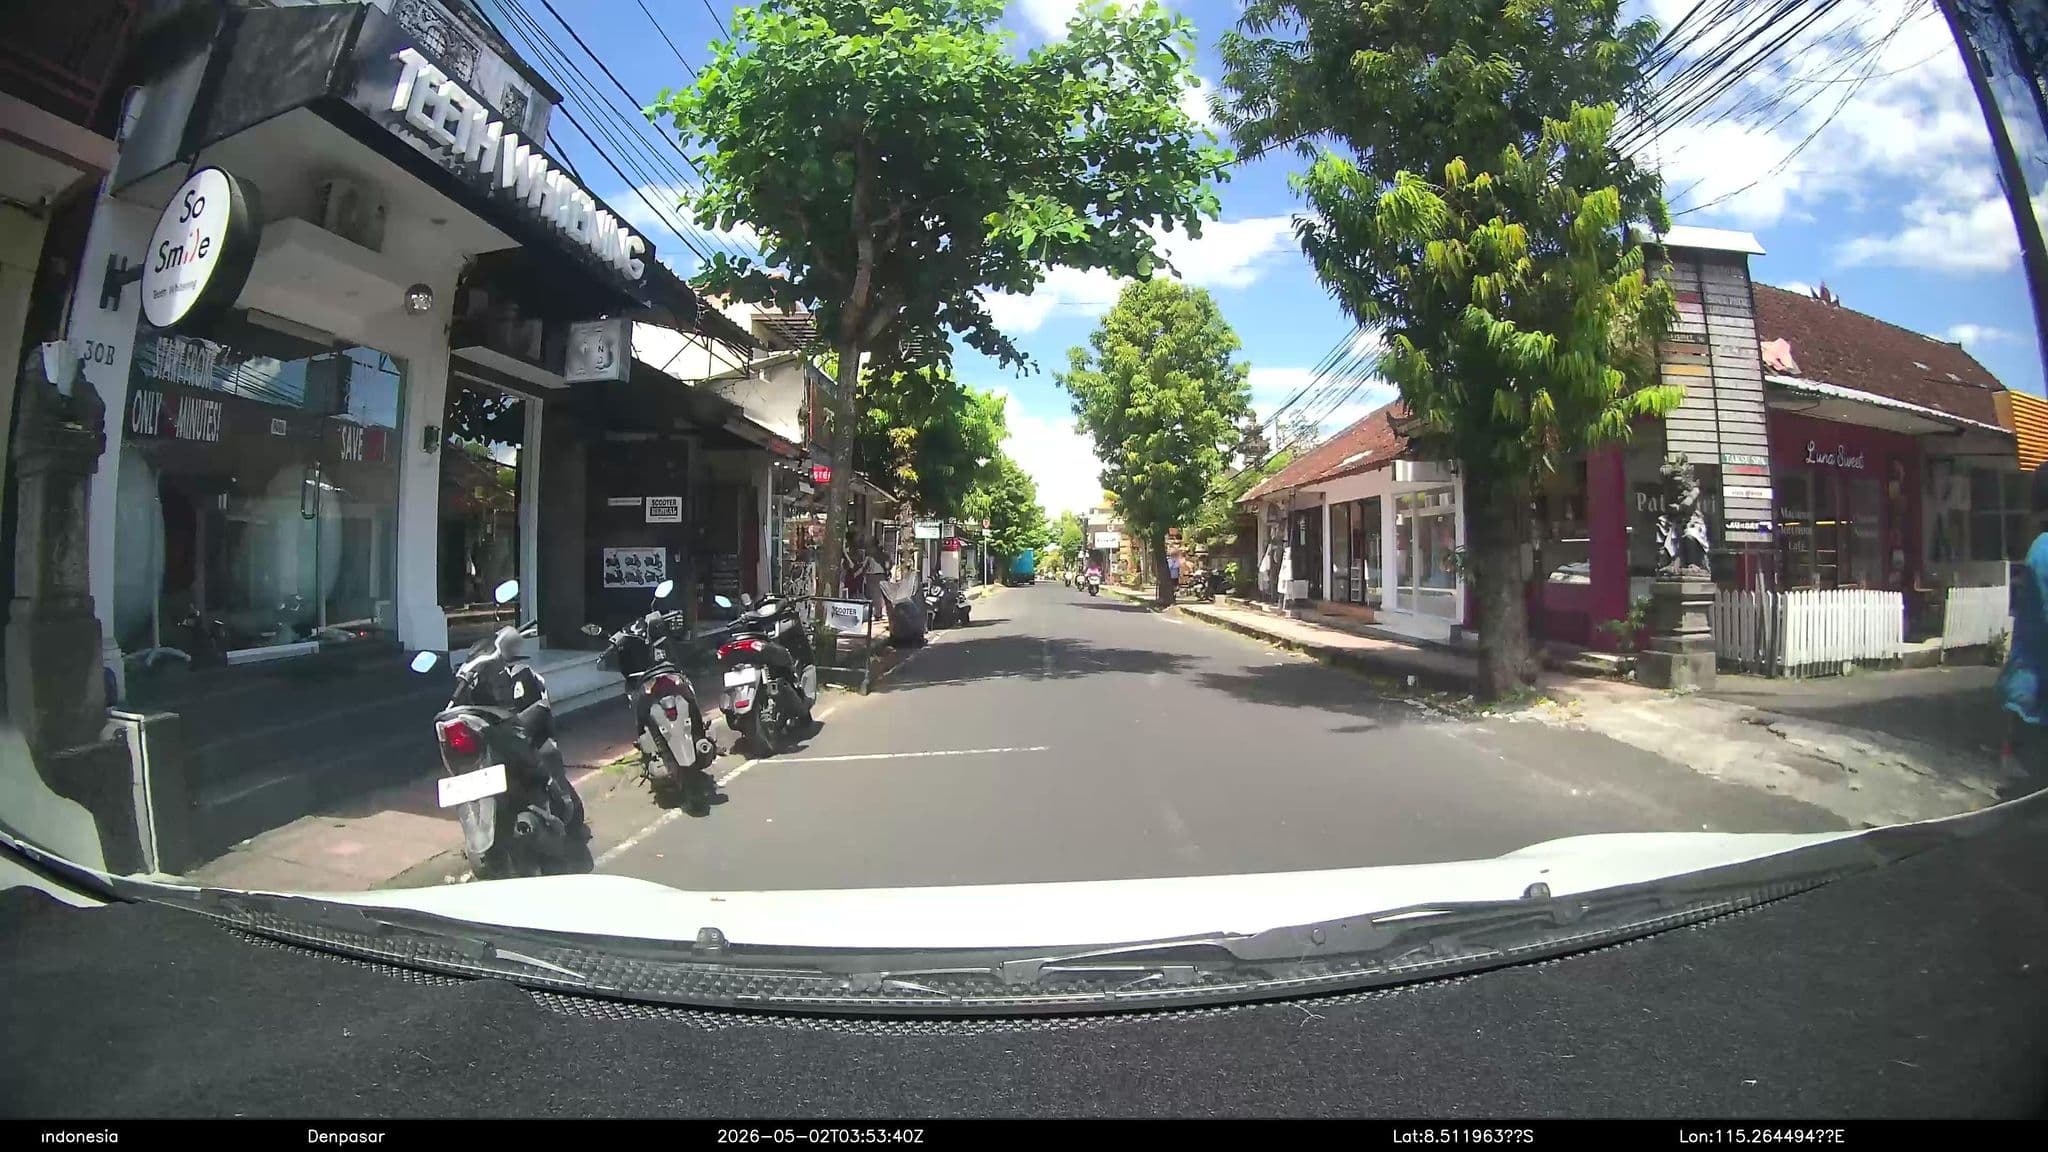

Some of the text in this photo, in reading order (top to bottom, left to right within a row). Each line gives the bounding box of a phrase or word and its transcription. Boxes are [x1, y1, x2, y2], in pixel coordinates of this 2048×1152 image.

[390, 48, 503, 173] TEETH
[180, 189, 205, 223] So
[132, 390, 163, 436] ONLY
[341, 425, 363, 461] SAVE
[1806, 440, 1834, 465] Luna
